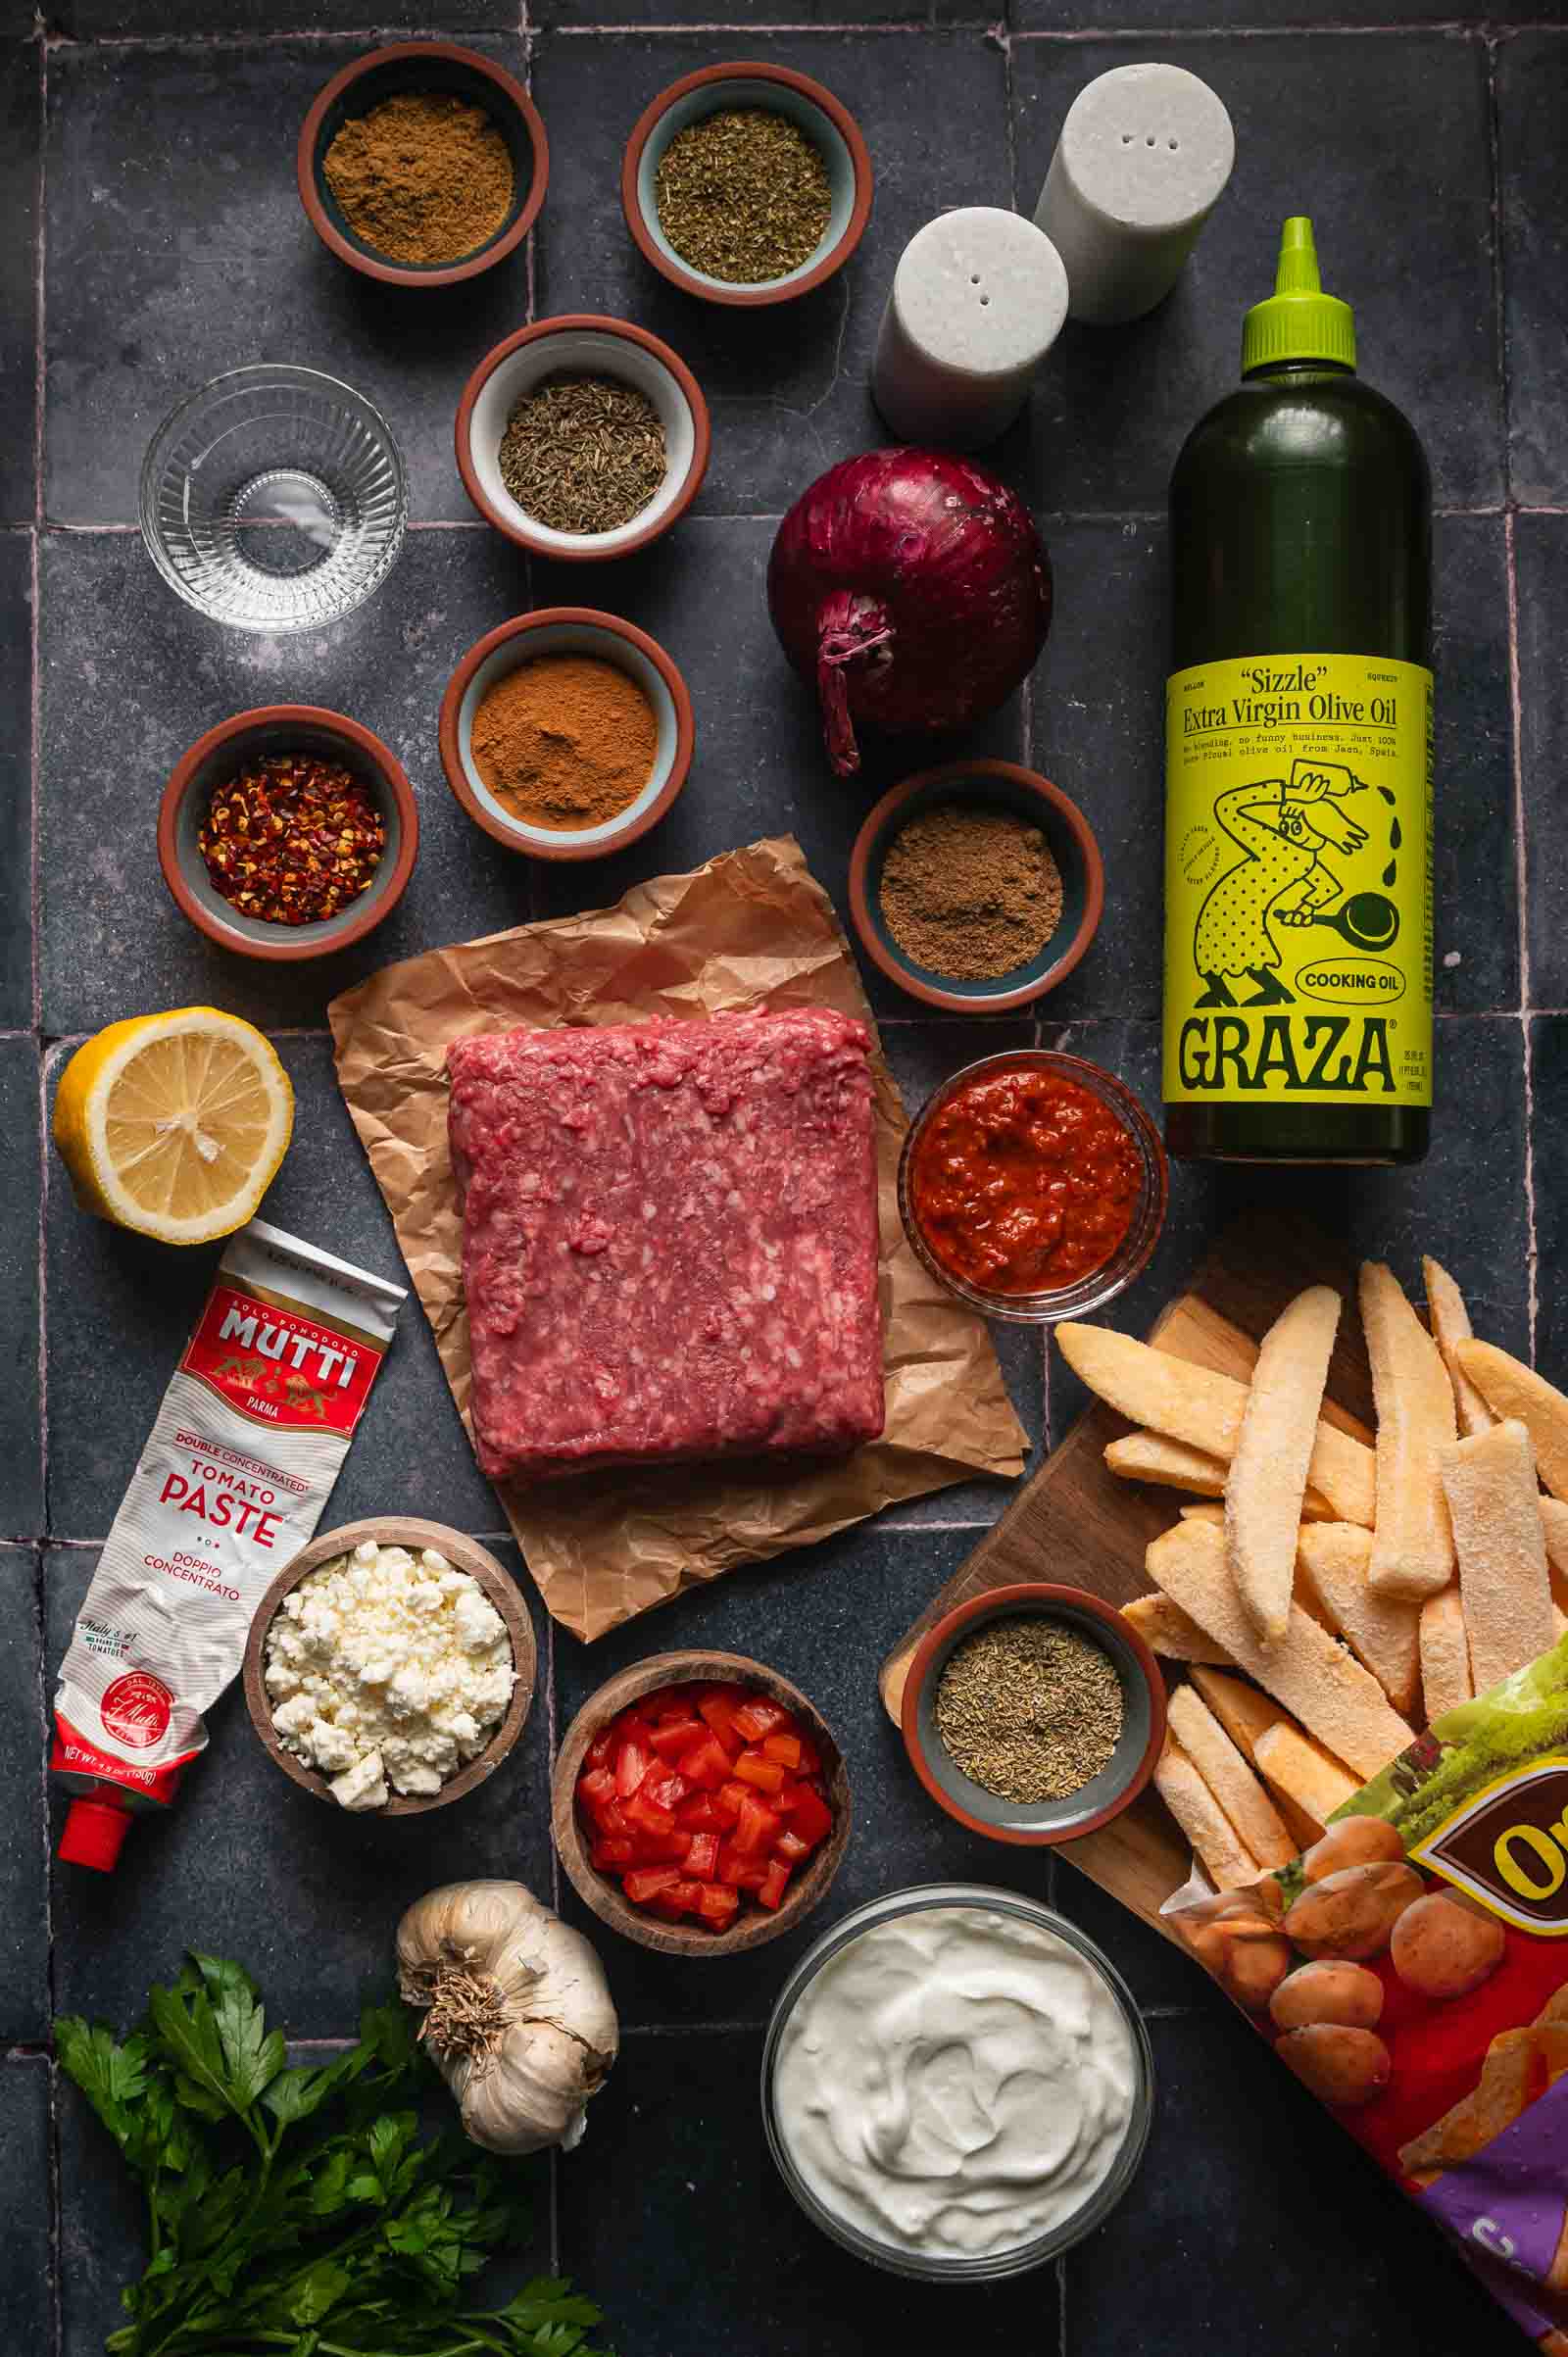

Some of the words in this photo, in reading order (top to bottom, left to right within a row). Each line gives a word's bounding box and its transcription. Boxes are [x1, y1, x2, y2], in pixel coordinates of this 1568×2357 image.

[1183, 707, 1226, 733] Extra
[1232, 699, 1299, 728] Virgin
[1308, 694, 1364, 720] Olive
[1371, 698, 1396, 724] Oil
[1239, 746, 1268, 755] olive
[1256, 733, 1286, 743] funny
[1304, 973, 1376, 989] COOKING
[1378, 974, 1399, 990] OIL
[219, 1307, 357, 1389] MUTTI
[246, 1397, 279, 1418] PARMA
[175, 1432, 220, 1457] DOUBLE
[191, 1458, 275, 1505] TOMATO
[159, 1472, 284, 1548] PASTE
[143, 1554, 240, 1601] CONCENTRATO
[172, 1551, 221, 1579] DOPPIO
[89, 1643, 124, 1657] TOMATOES
[65, 1745, 80, 1760] NET
